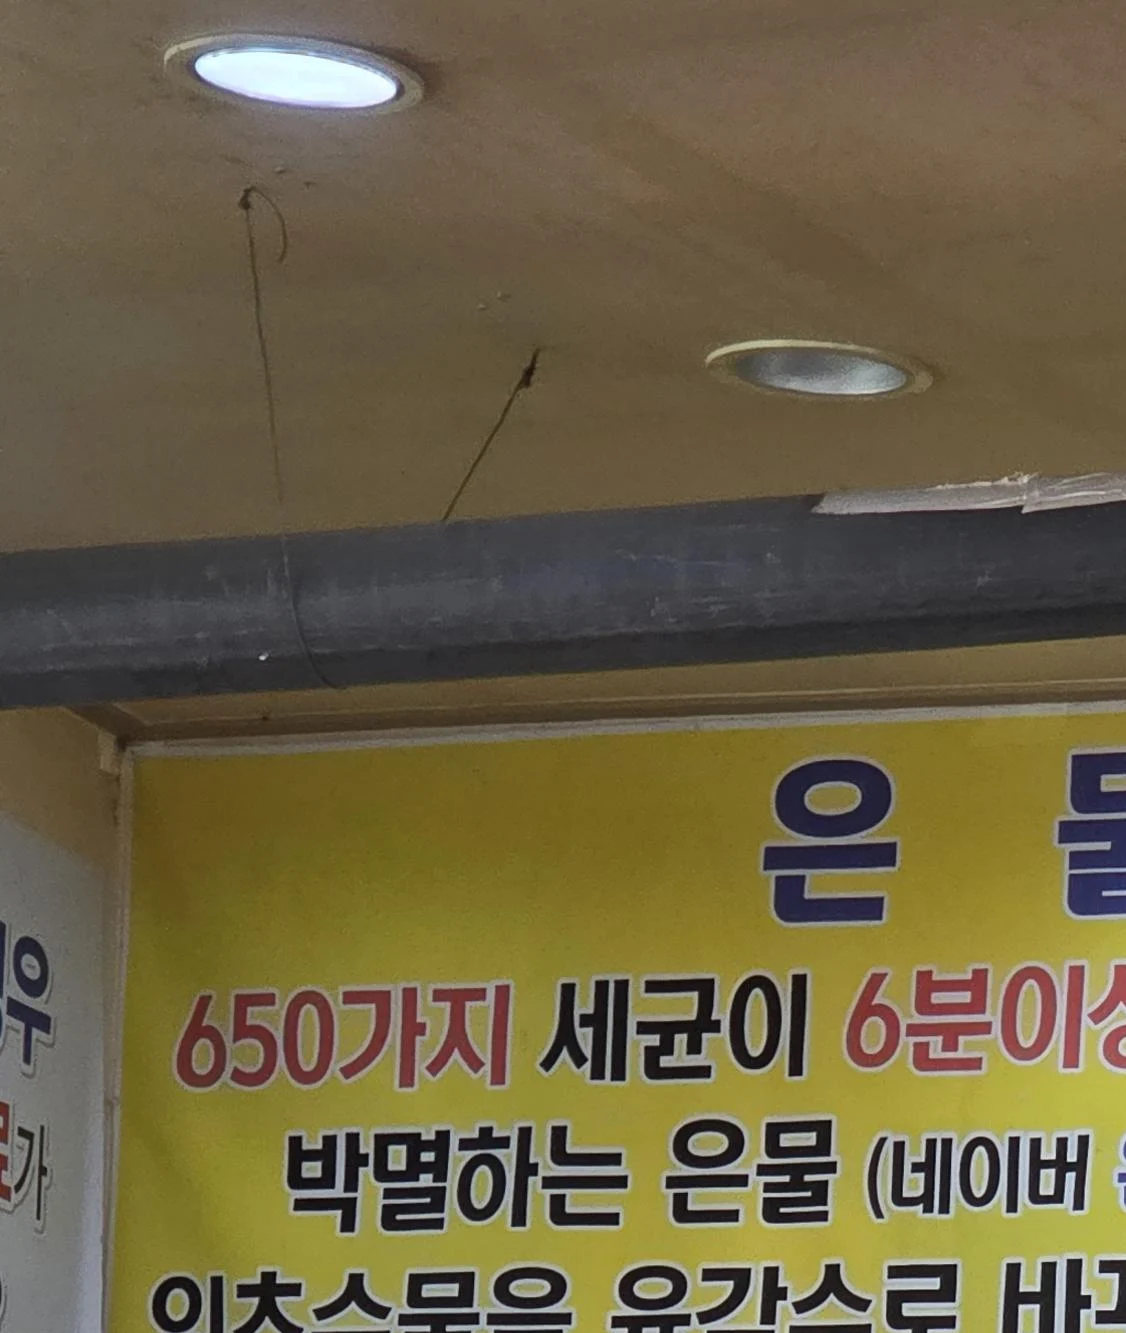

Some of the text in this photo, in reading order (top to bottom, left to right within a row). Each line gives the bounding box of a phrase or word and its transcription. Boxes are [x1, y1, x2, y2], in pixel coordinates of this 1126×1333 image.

[763, 760, 897, 923] 은
[0, 921, 52, 1066] 우
[177, 986, 508, 1087] 650가지
[540, 974, 807, 1081] 세균이
[287, 1126, 628, 1232] 박멸하는
[666, 1119, 837, 1223] 은물
[868, 1135, 1089, 1218] (네이버
